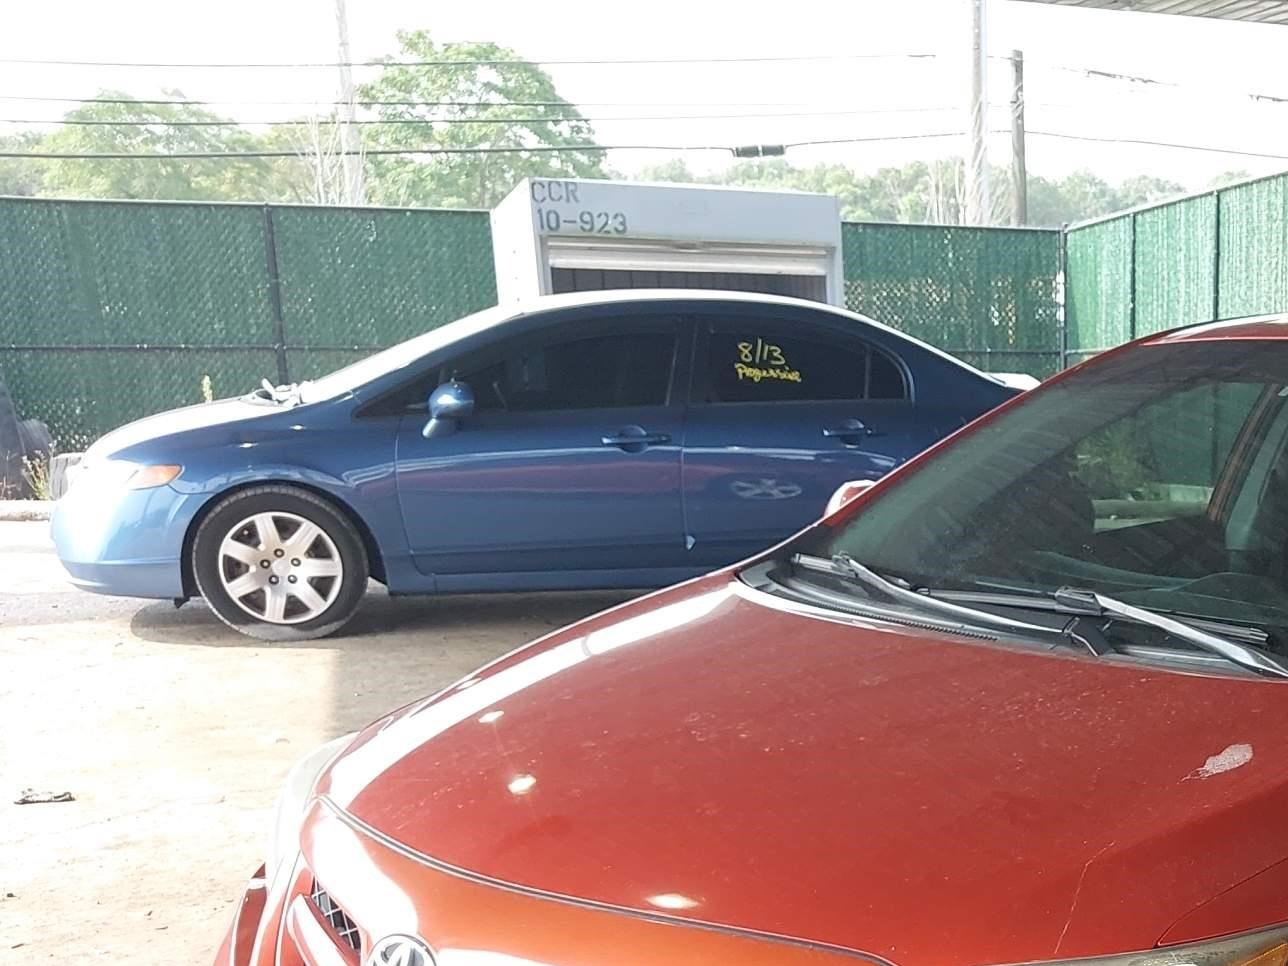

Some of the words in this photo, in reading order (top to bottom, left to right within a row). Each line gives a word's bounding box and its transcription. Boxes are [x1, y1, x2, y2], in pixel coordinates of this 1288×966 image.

[531, 181, 579, 203] CCR
[537, 208, 628, 234] 10-923
[737, 337, 786, 365] 8/13
